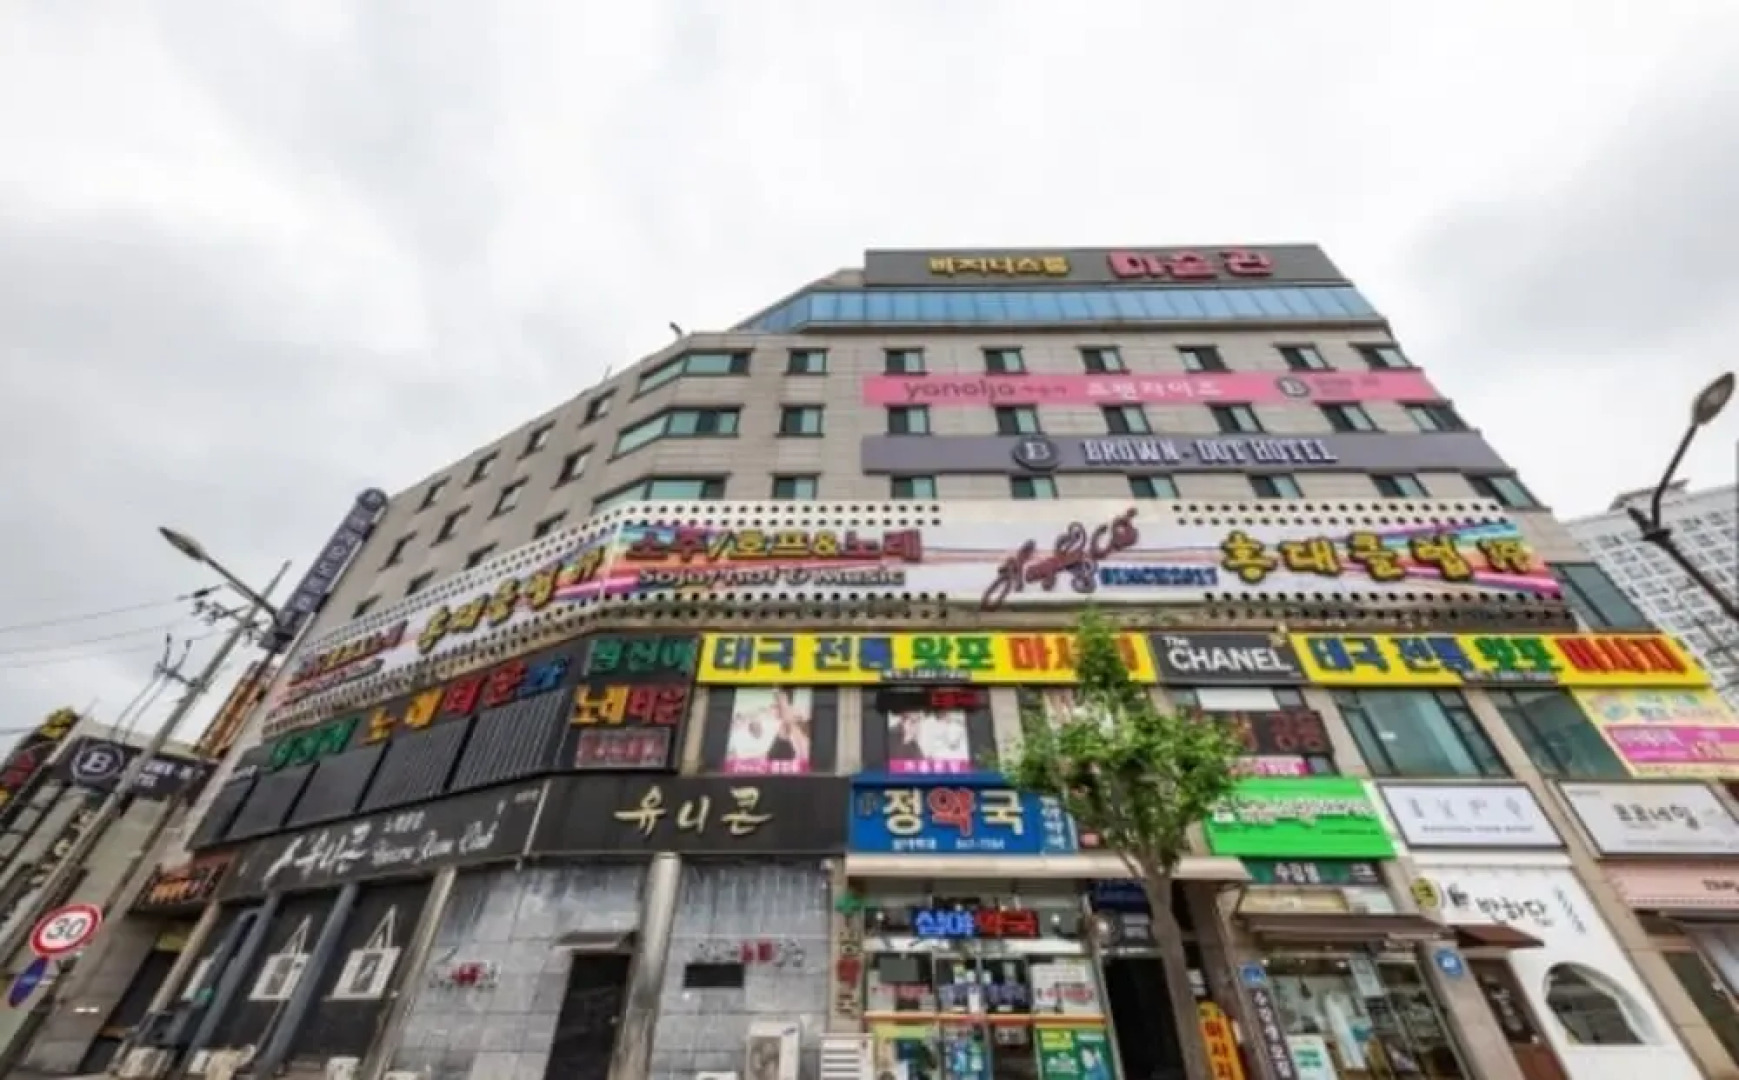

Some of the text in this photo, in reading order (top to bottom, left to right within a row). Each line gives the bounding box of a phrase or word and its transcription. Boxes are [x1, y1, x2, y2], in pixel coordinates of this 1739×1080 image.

[1247, 439, 1339, 464] HOTEL
[711, 636, 795, 674] 태국
[910, 637, 994, 672] 왓포
[1162, 635, 1190, 647] The
[1305, 636, 1390, 673] 태국
[1168, 647, 1294, 672] CHANEL
[614, 785, 773, 837] 유니콘
[882, 786, 1025, 837] 정약국
[45, 917, 87, 939] 30
